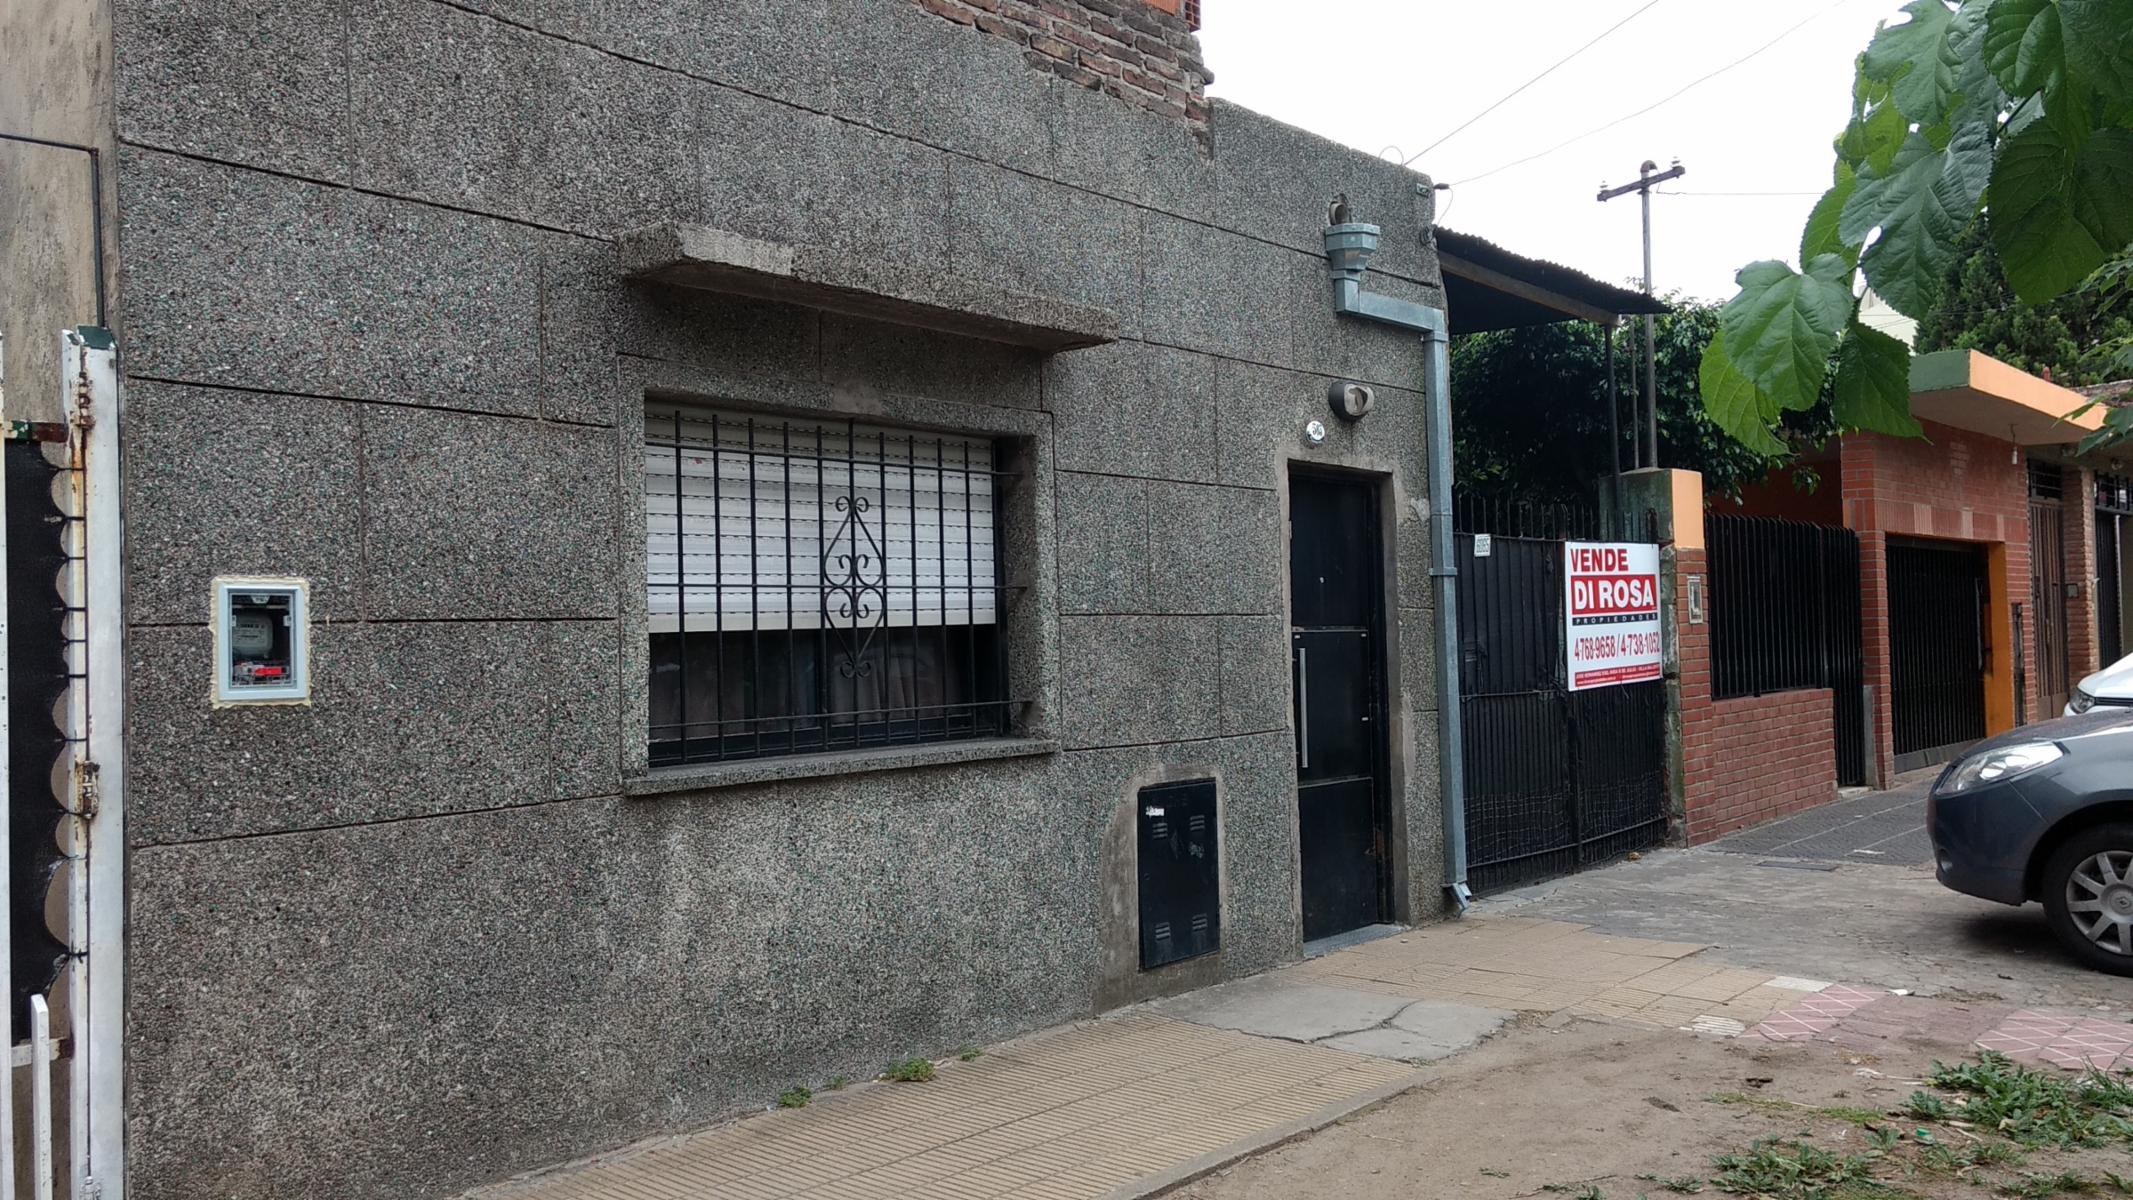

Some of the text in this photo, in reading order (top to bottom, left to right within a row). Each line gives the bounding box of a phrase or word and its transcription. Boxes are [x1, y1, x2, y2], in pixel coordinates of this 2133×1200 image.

[1570, 549, 1628, 572] VENDE
[1574, 579, 1654, 610] DI ROSA
[1576, 613, 1656, 625] PROPIEDADES
